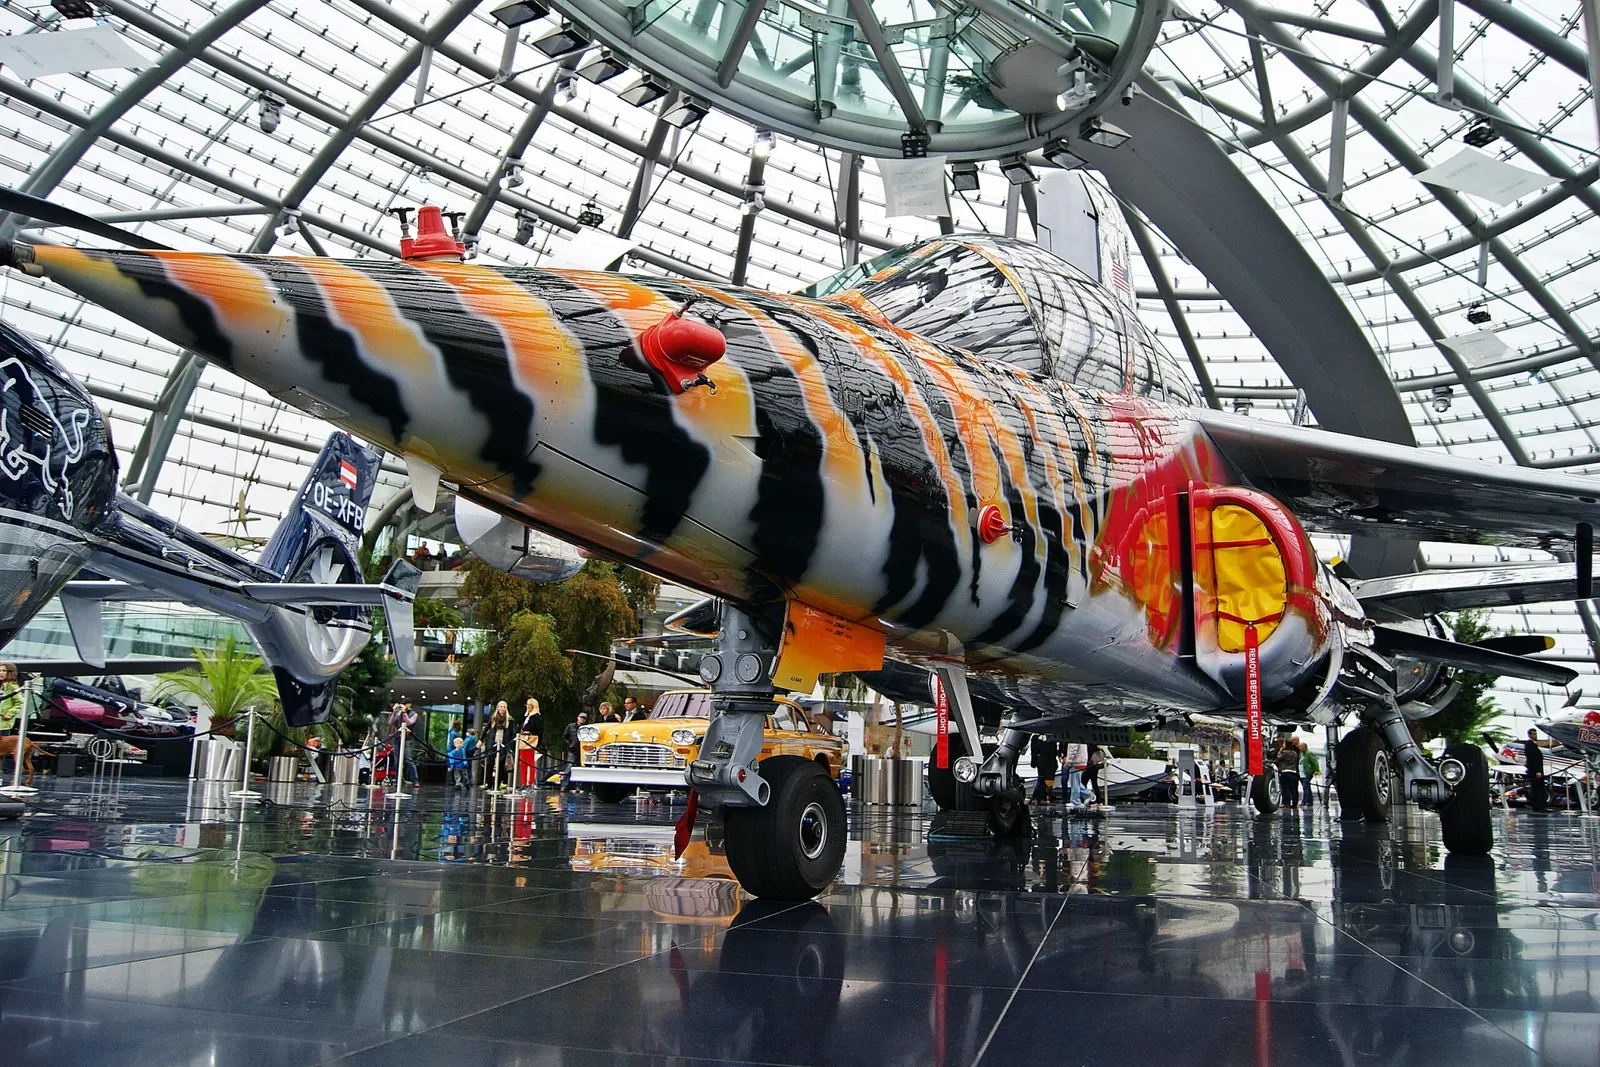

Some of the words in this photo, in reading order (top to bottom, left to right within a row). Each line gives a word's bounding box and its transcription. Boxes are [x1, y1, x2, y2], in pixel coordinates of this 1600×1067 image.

[314, 481, 364, 531] OE-XFB
[1248, 648, 1257, 678] REMOVE
[939, 680, 947, 708] FORE
[1250, 680, 1258, 710] BEFORE
